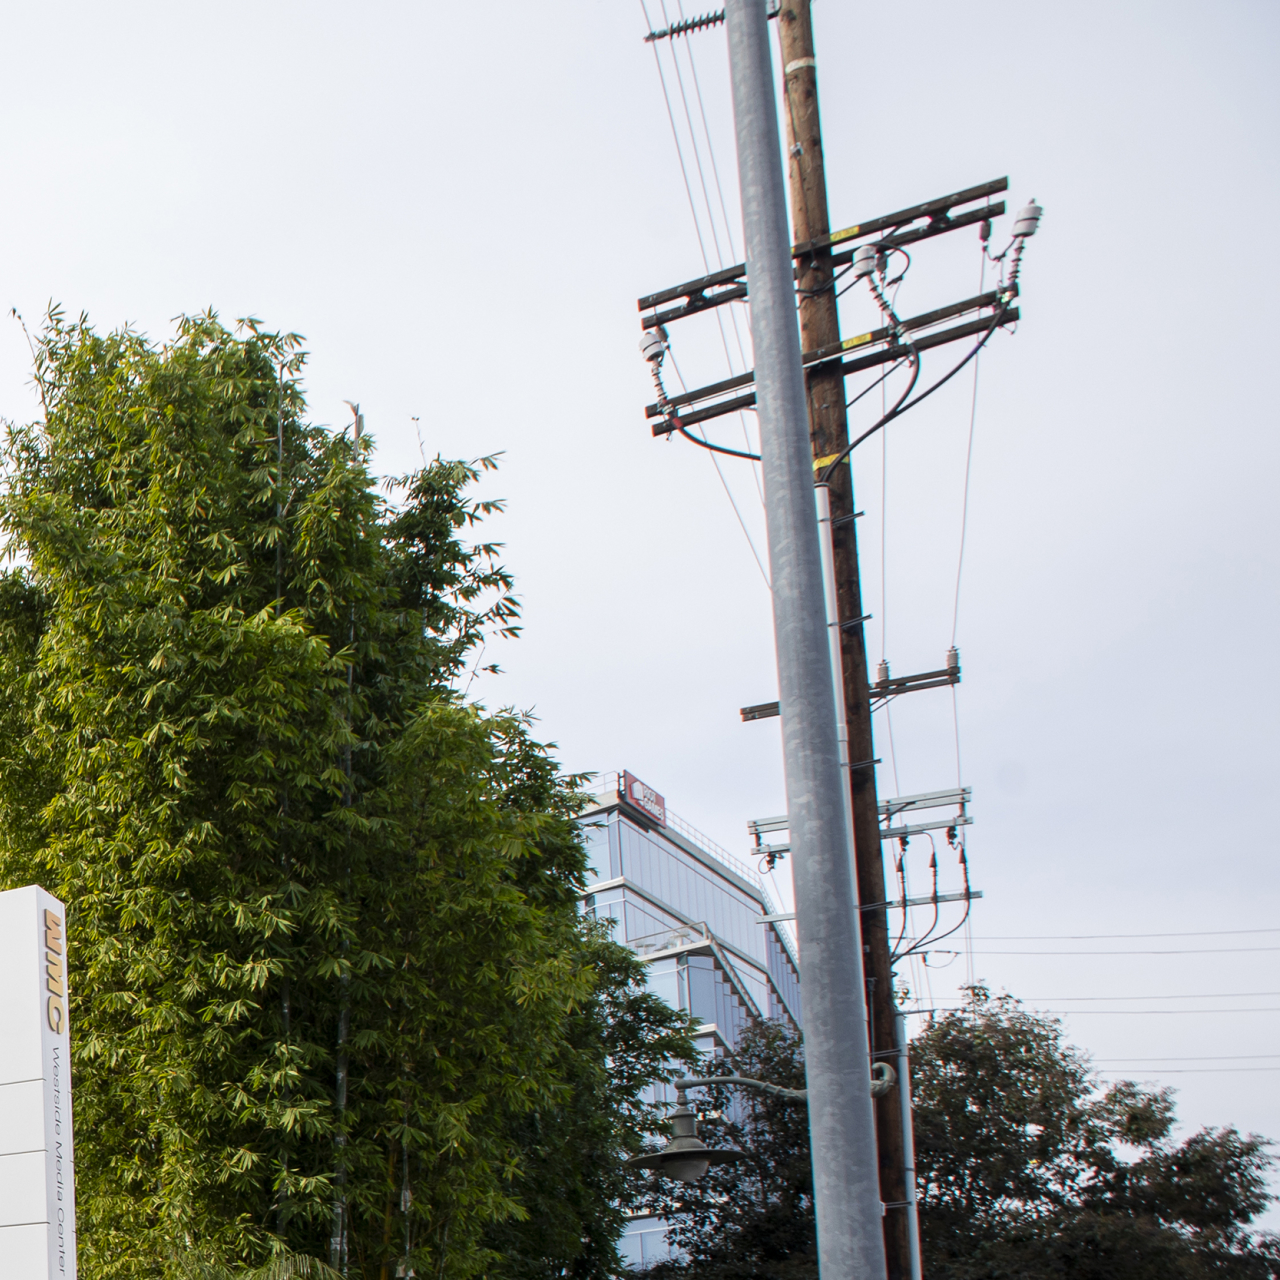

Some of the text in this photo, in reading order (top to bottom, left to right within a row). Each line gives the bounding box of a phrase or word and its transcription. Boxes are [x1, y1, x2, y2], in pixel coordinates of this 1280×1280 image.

[643, 798, 664, 820] GAMES
[44, 908, 66, 1276] WMC Westside Media Center
